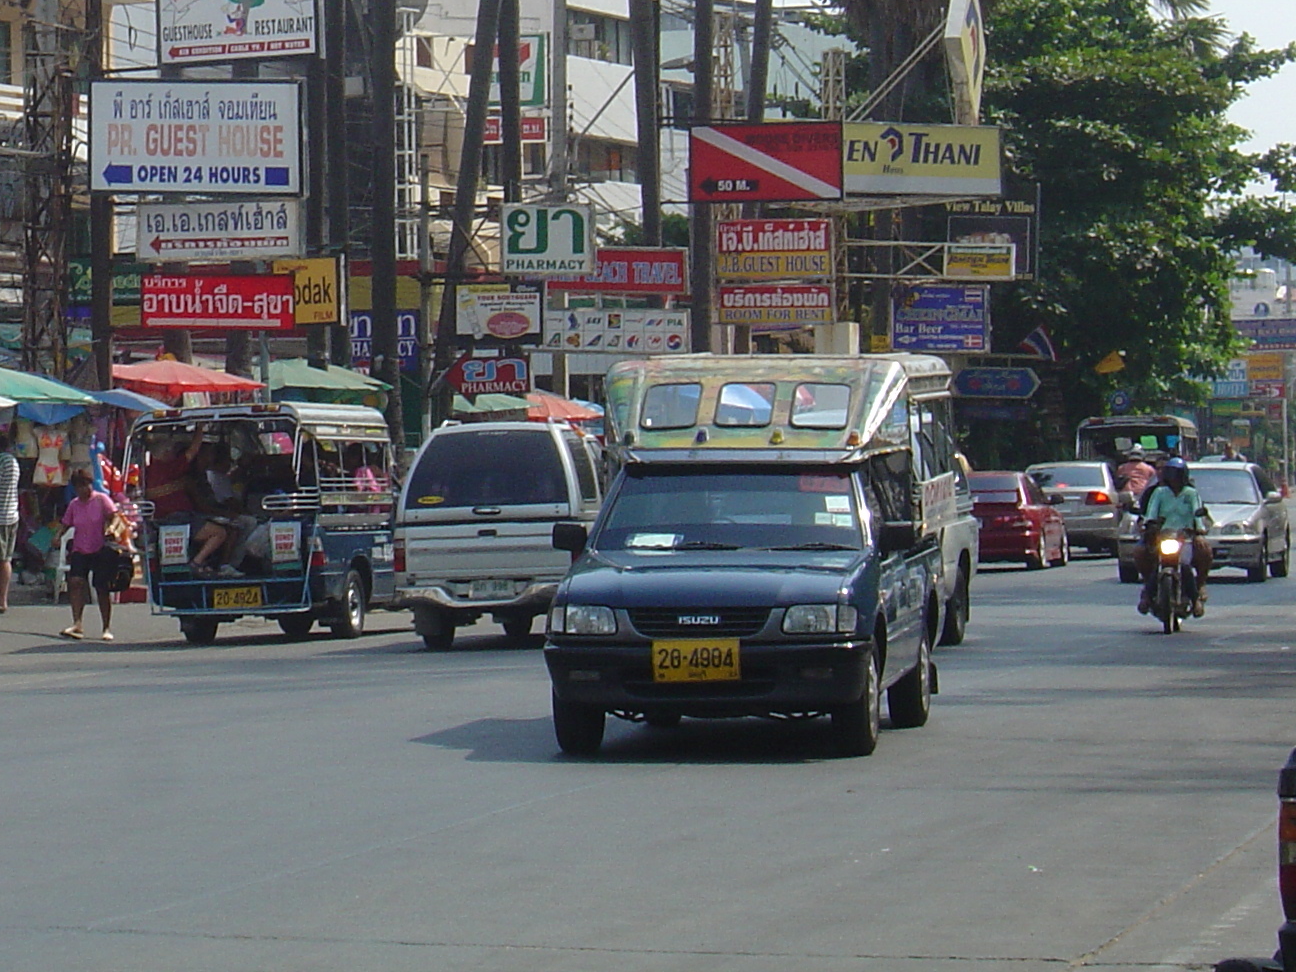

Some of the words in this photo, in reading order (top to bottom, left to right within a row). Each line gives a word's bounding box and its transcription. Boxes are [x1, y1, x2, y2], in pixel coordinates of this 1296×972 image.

[162, 23, 213, 42] GUESTHOUSE
[254, 16, 313, 36] RESTAURANT
[130, 93, 153, 119] อาร์
[218, 92, 278, 121] จอมเทียน
[107, 123, 137, 156] PR.
[145, 124, 210, 158] GUEST
[218, 124, 284, 158] HOUSE
[907, 132, 982, 166] THANI
[137, 165, 178, 183] OPEN
[182, 166, 204, 184] 24
[208, 166, 262, 185] HOURS
[717, 180, 733, 192] 50
[735, 180, 751, 192] M.
[945, 202, 971, 212] View
[972, 200, 1003, 216] Talay
[1005, 200, 1035, 213] Villas
[507, 209, 585, 255] ยา
[506, 259, 586, 271] PHARMACY
[785, 255, 826, 272] HOUSE
[143, 274, 187, 289] บริการ
[632, 262, 683, 284] TRAVEL
[143, 279, 294, 320] อาบน้ำจืด-สุขา
[723, 287, 829, 307] บริการห้องพัก
[667, 318, 683, 327] PIA
[725, 308, 762, 320] ROOM
[767, 308, 791, 320] FOR
[795, 308, 826, 320] RENT
[895, 322, 915, 334] Bar
[918, 323, 944, 334] Beer
[461, 357, 527, 382] ยา
[461, 380, 528, 394] PHARMACY
[216, 589, 259, 606] 20-4924
[678, 616, 719, 625] ISUZU
